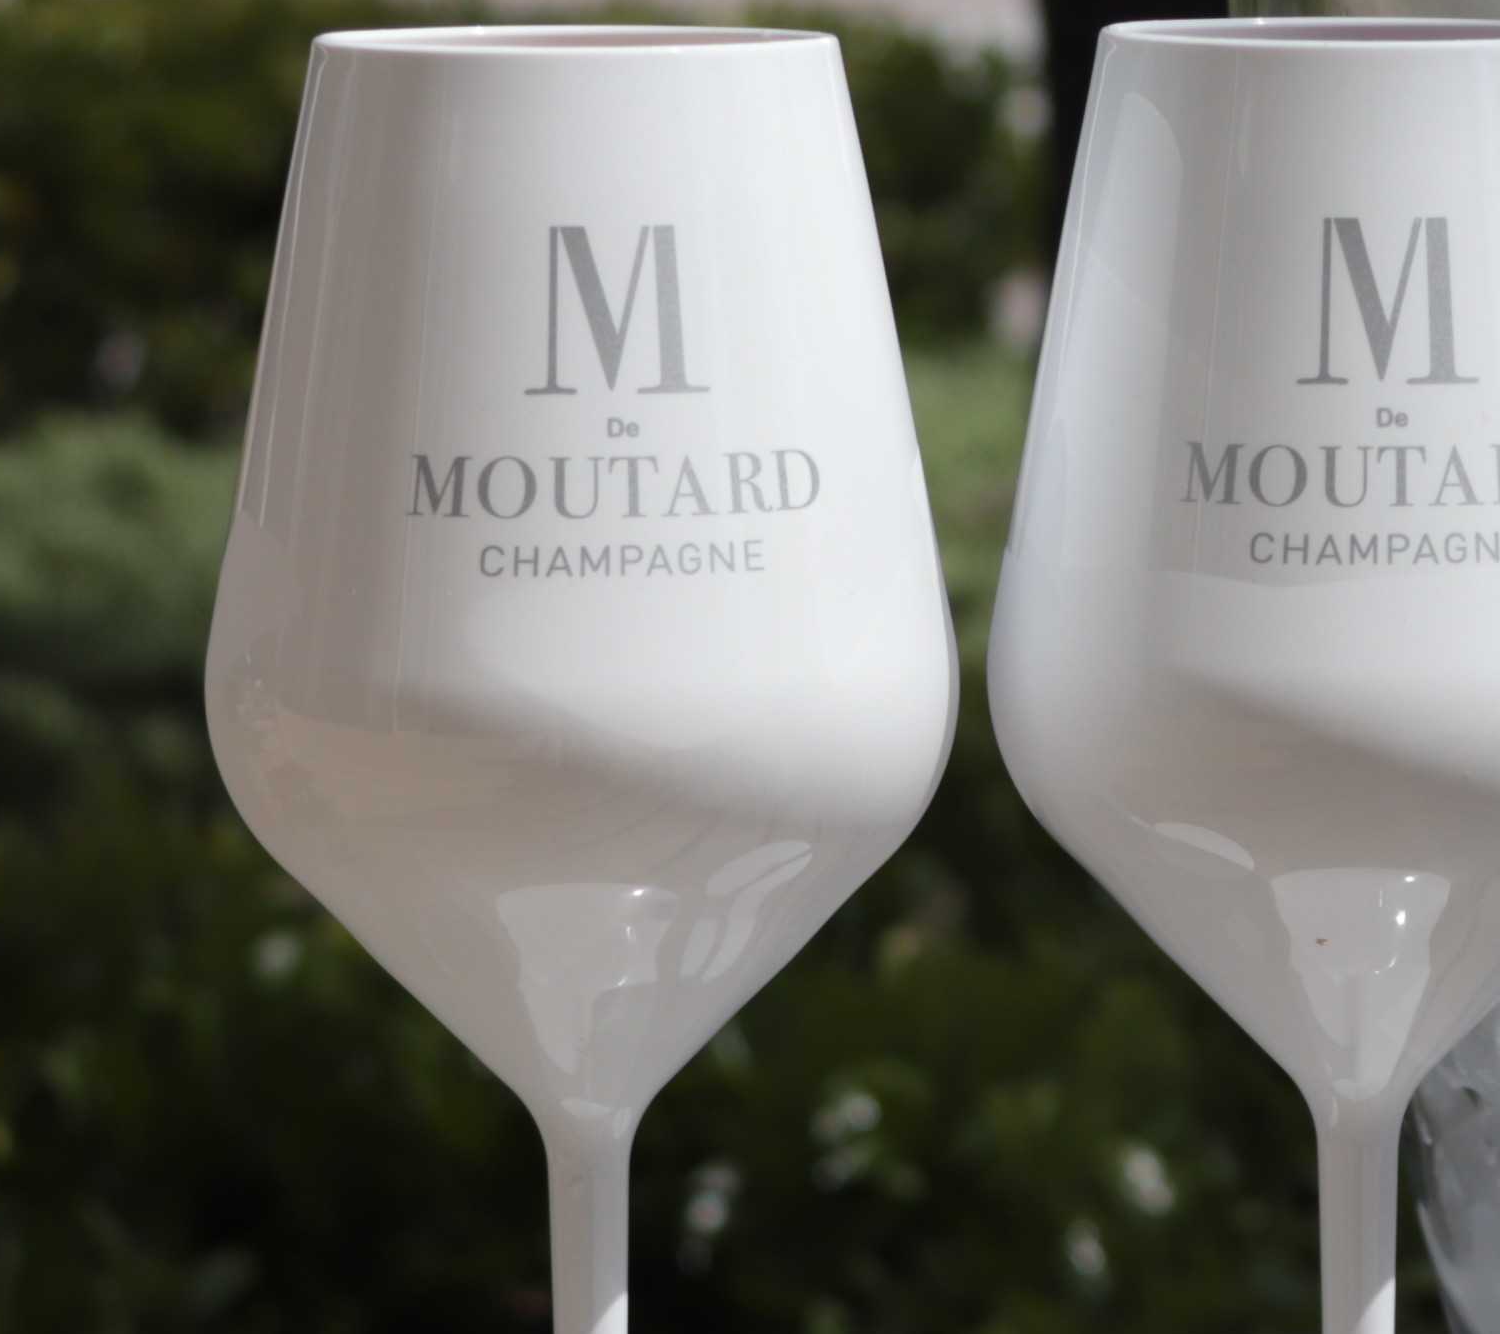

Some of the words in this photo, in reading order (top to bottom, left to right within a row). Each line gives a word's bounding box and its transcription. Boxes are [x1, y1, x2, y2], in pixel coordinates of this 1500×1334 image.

[524, 224, 711, 396] M
[1296, 217, 1480, 385] M
[606, 417, 640, 439] De
[1375, 407, 1409, 428] De
[406, 449, 820, 520] MOUTARD
[479, 539, 766, 578] CHAMPAGNE
